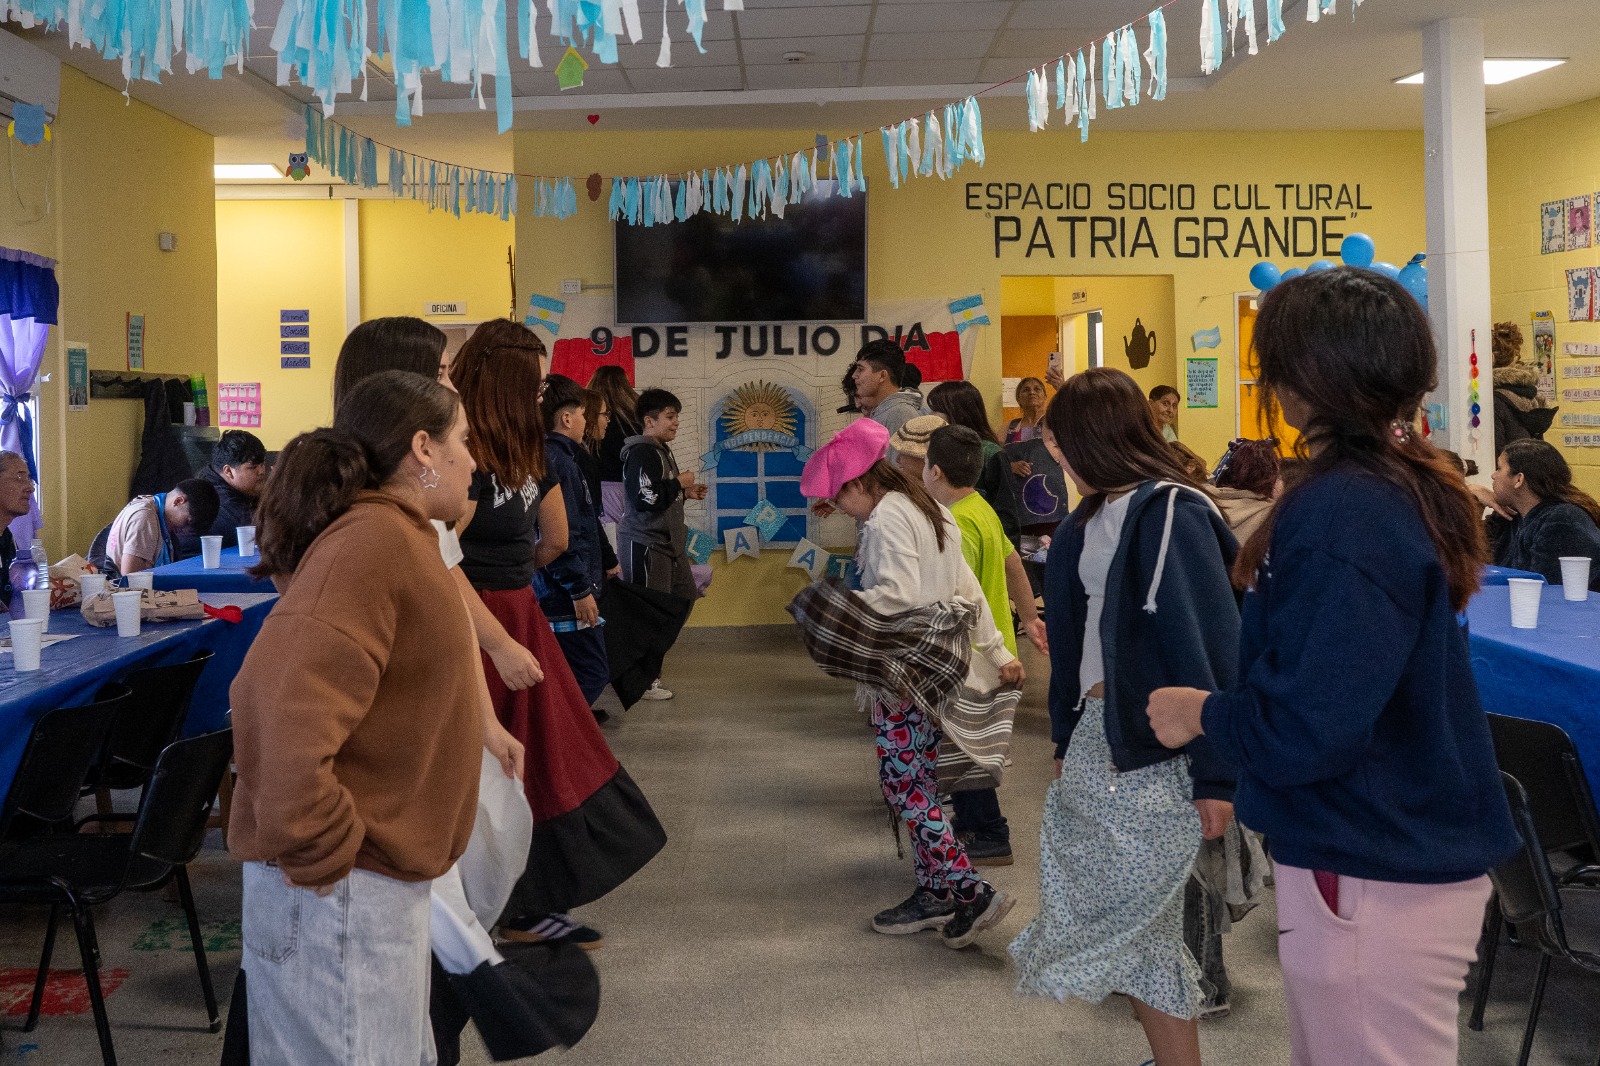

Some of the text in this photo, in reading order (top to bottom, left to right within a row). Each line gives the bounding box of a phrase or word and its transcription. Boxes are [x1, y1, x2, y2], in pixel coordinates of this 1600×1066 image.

[966, 182, 1373, 211] ESPACIO SOCIO CULTURAL
[431, 303, 458, 313] OFICINA
[590, 321, 931, 360] 9 DE JULIO DIA
